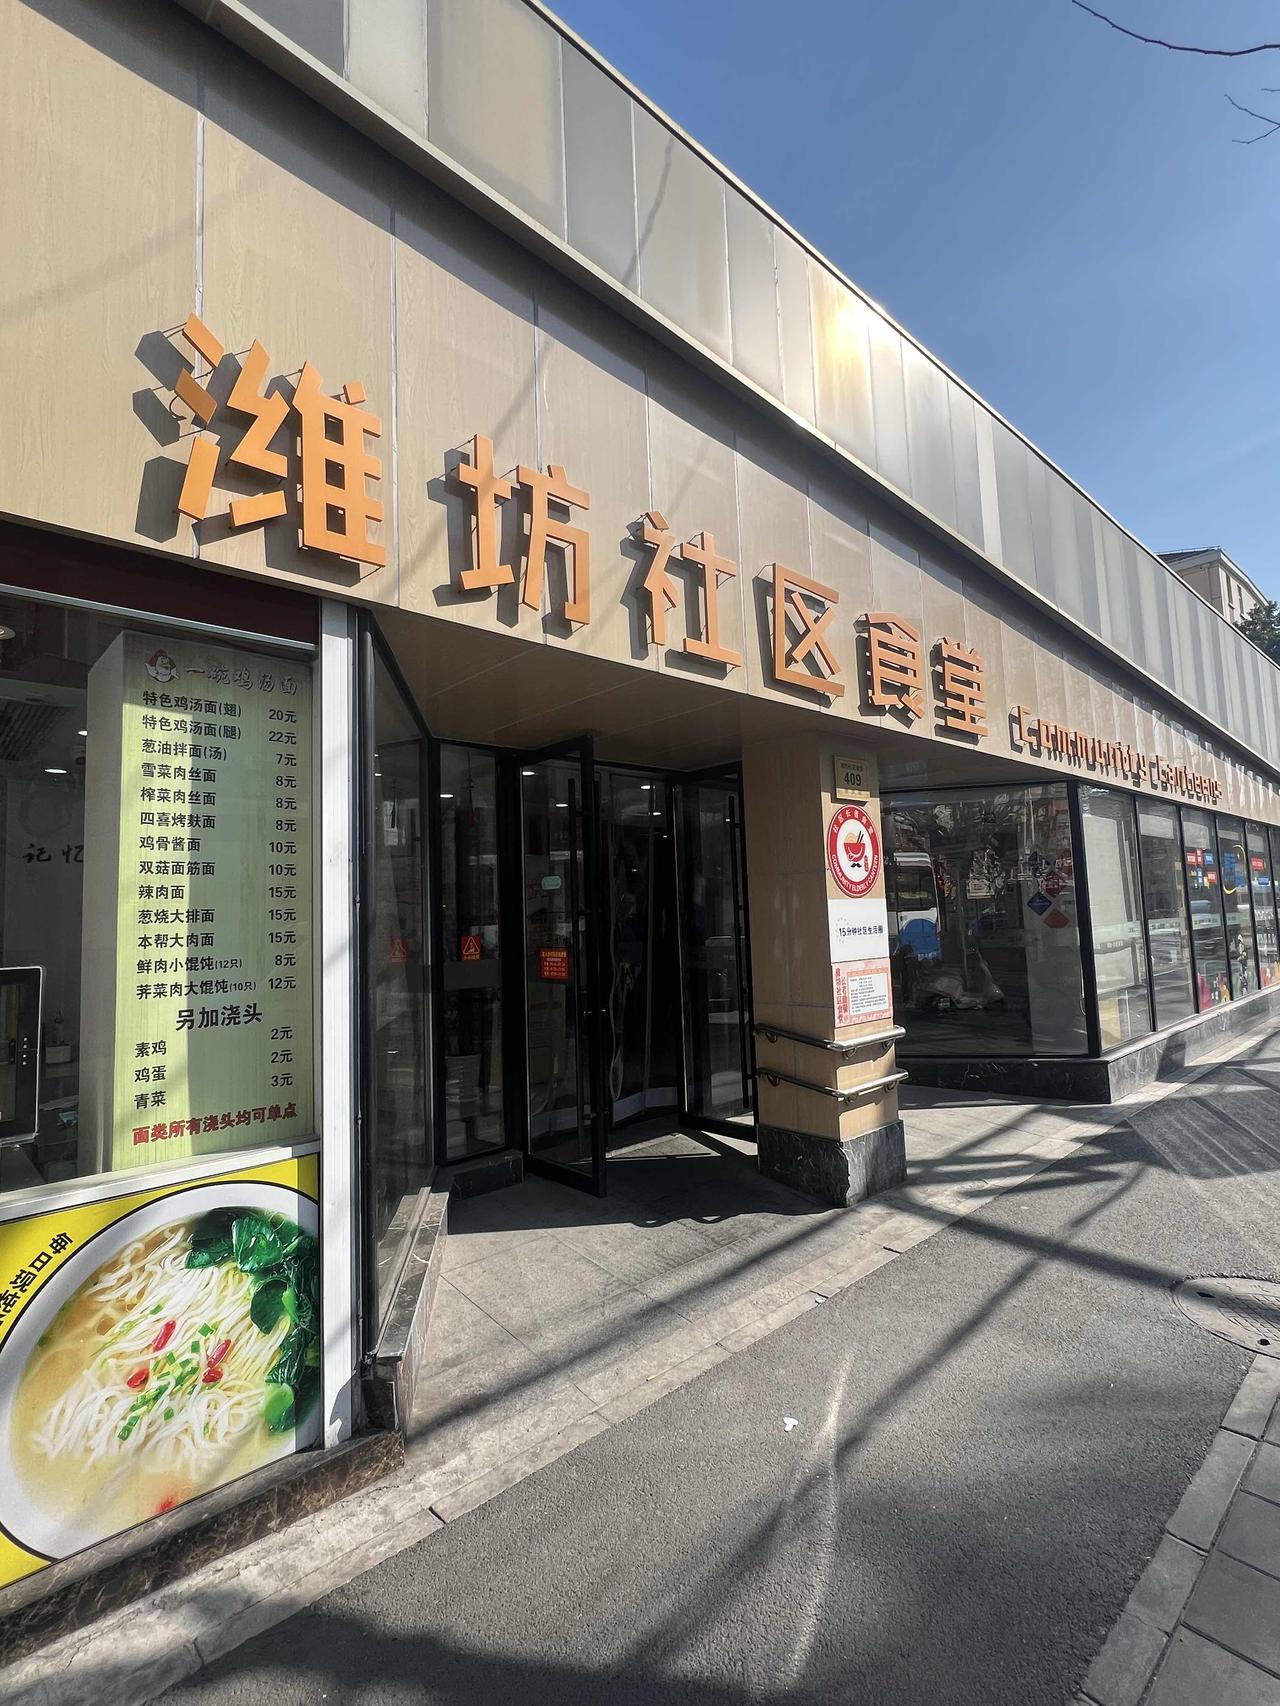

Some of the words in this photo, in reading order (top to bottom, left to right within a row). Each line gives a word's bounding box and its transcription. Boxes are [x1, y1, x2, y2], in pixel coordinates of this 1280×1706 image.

[175, 312, 989, 738] 潍坊社区食堂
[185, 664, 298, 696] 一碗鸡汤面
[142, 690, 242, 718] 特色鸡汤面(翅)
[268, 708, 297, 724] 20元
[142, 715, 242, 740] 特色鸡汤面(腿)
[268, 731, 297, 745] 22元
[1018, 706, 1147, 782] Community
[142, 739, 228, 761] 葱油拌面(汤)
[275, 753, 297, 767] 7元
[141, 762, 217, 783] 雪菜肉丝面
[275, 775, 297, 789] 8元
[844, 772, 862, 787] 409
[140, 786, 216, 806] 榨菜肉丝面
[275, 797, 297, 811] 8元
[140, 811, 216, 829] 四喜烤麸面
[275, 819, 297, 832] 8元
[139, 836, 201, 852] 鸡骨酱面
[269, 841, 297, 854] 10元
[139, 860, 216, 876] 双菇面筋面
[269, 864, 297, 877] 10元
[138, 885, 185, 900] 辣肉面
[268, 886, 297, 899] 15元
[138, 908, 215, 924] 葱烧大排面
[268, 908, 297, 921] 15元
[137, 932, 215, 950] 本帮大肉面
[268, 931, 297, 944] 15元
[136, 956, 243, 975] 鲜肉小馄饨(12只)
[275, 953, 297, 967] 8元
[136, 978, 257, 1000] 荠菜肉大馄饨(10只)
[268, 976, 297, 990] 12元
[175, 1003, 263, 1031] 另加浇头
[135, 1039, 167, 1059] 素鸡
[271, 1026, 293, 1041] 2元
[134, 1065, 167, 1083] 鸡蛋
[271, 1049, 293, 1064] 2元
[134, 1091, 167, 1110] 青菜
[271, 1073, 293, 1087] 3元
[132, 1102, 298, 1146] 面类所有浇头均可单点
[0, 1232, 74, 1327] 每日现炖
